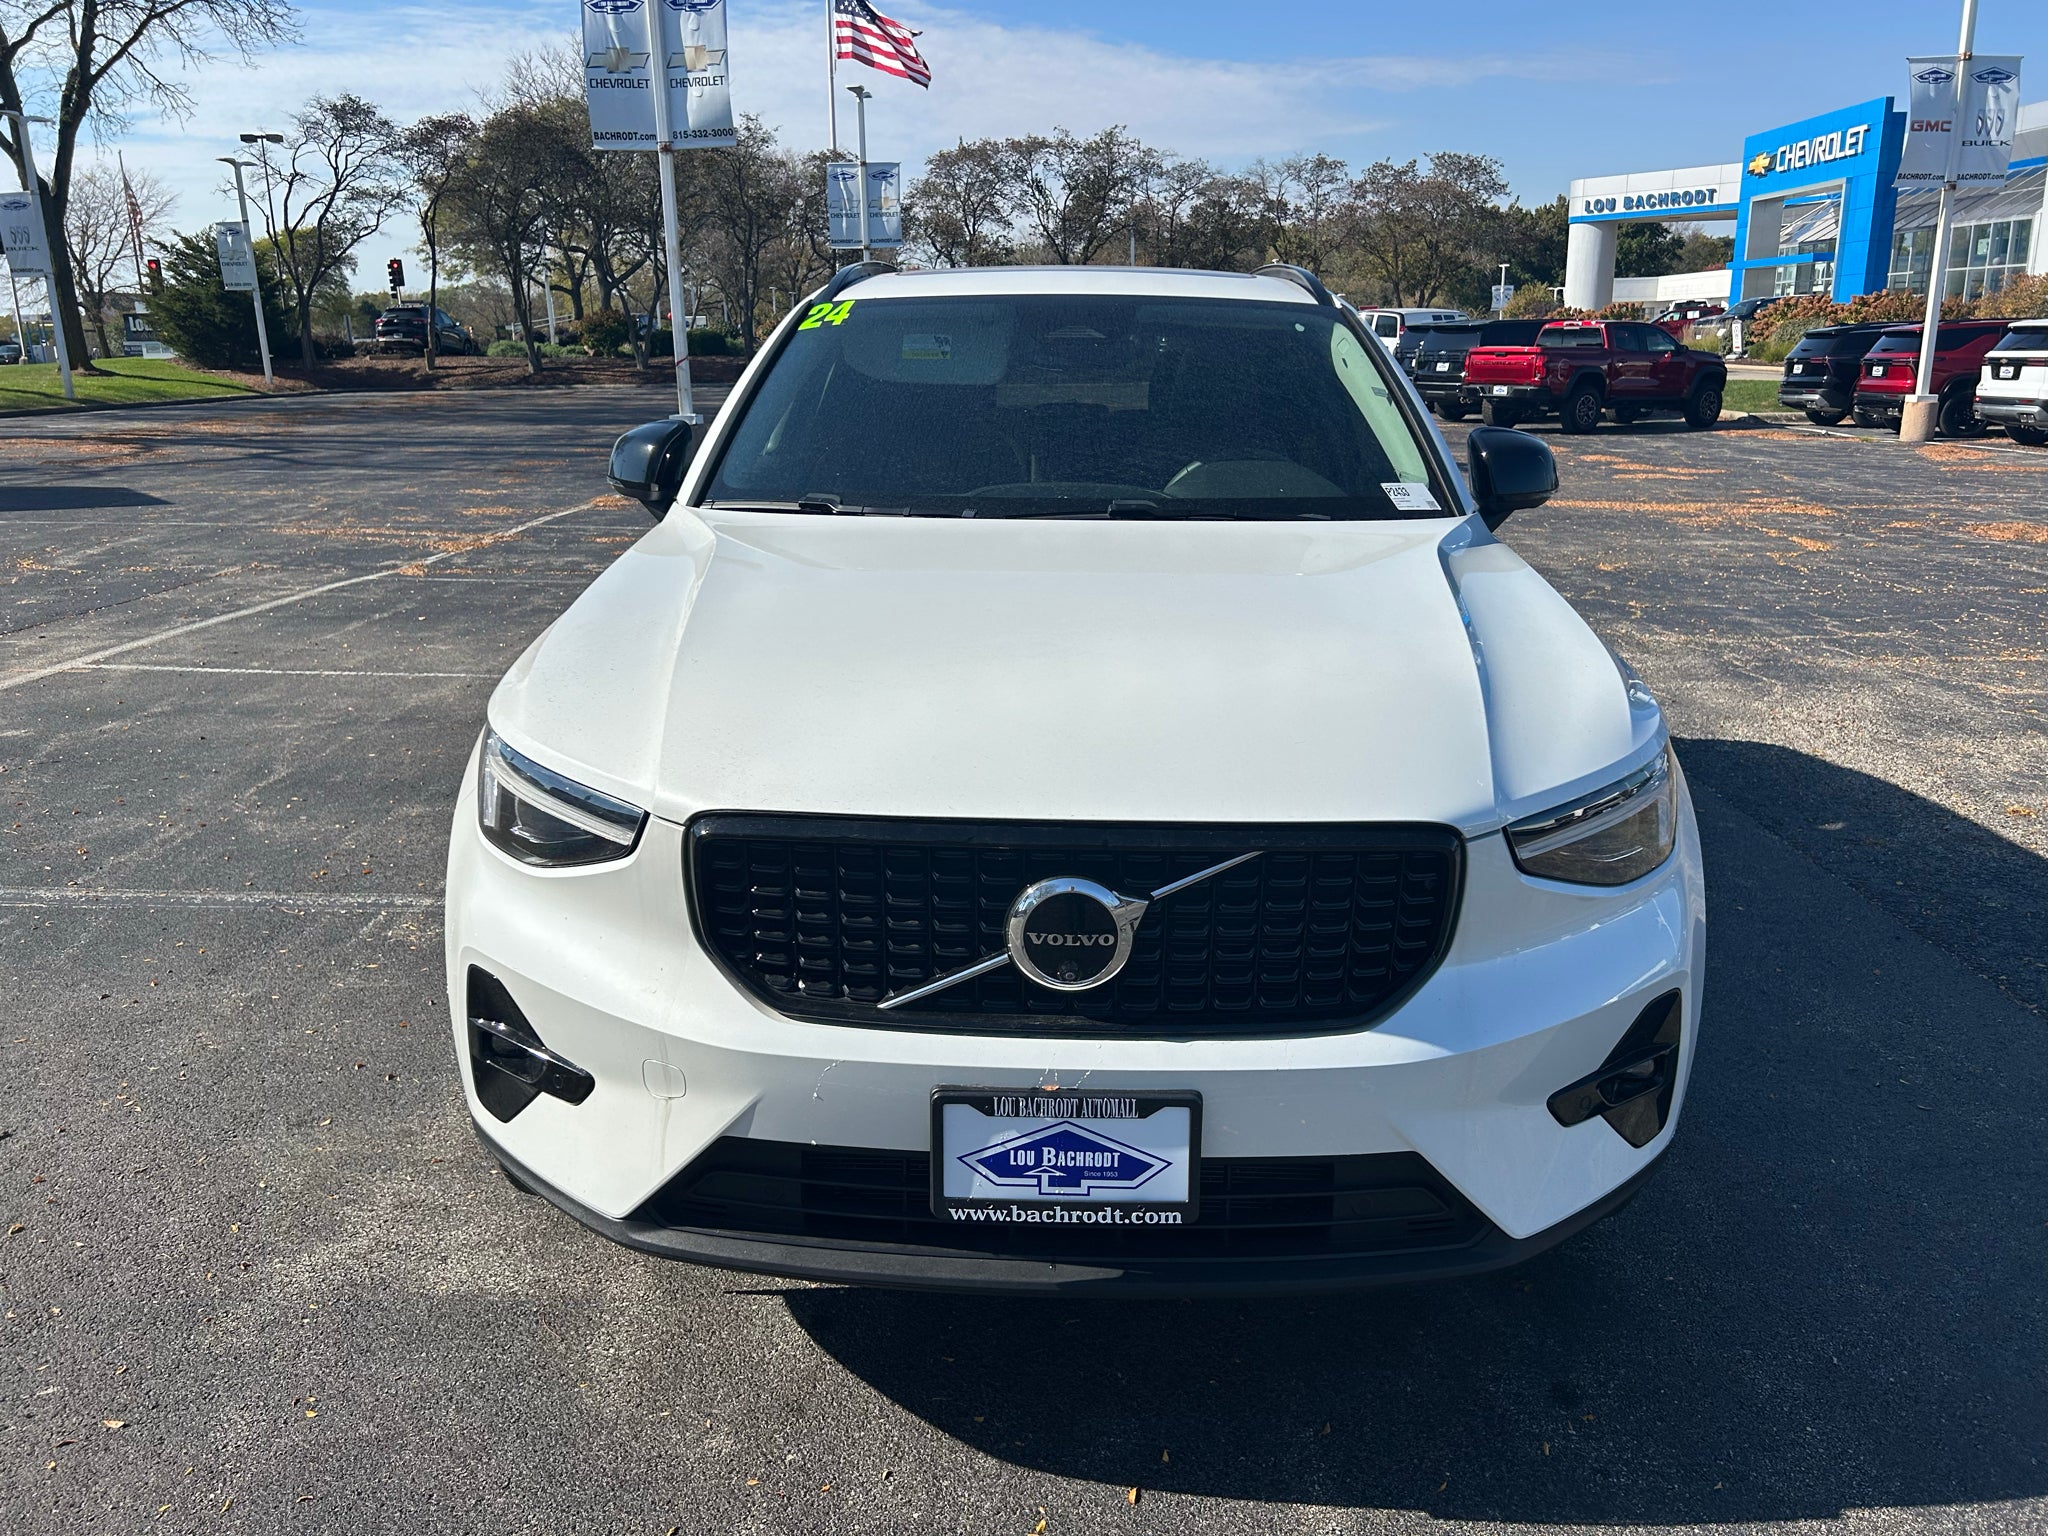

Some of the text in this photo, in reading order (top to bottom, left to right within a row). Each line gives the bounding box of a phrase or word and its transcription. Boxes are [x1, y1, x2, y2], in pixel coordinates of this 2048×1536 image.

[589, 78, 650, 89] CHEVROLET
[669, 75, 725, 89] CHEVROLET
[1910, 120, 1952, 132] GMC
[593, 131, 657, 141] BACHRODT.com
[672, 128, 734, 140] 815-332-3000
[1774, 123, 1870, 173] CHEVROLET
[1956, 173, 2005, 181] BACHRODT.com
[1584, 187, 1718, 215] LOU BACHRODT
[797, 299, 856, 331] 24
[1027, 932, 1115, 947] VOLVO
[993, 1096, 1139, 1119] LOU BACHRODT AUTOMALL
[1009, 1146, 1121, 1168] LOU BACHRODT
[948, 1205, 1183, 1225] www.bachrodt.com
